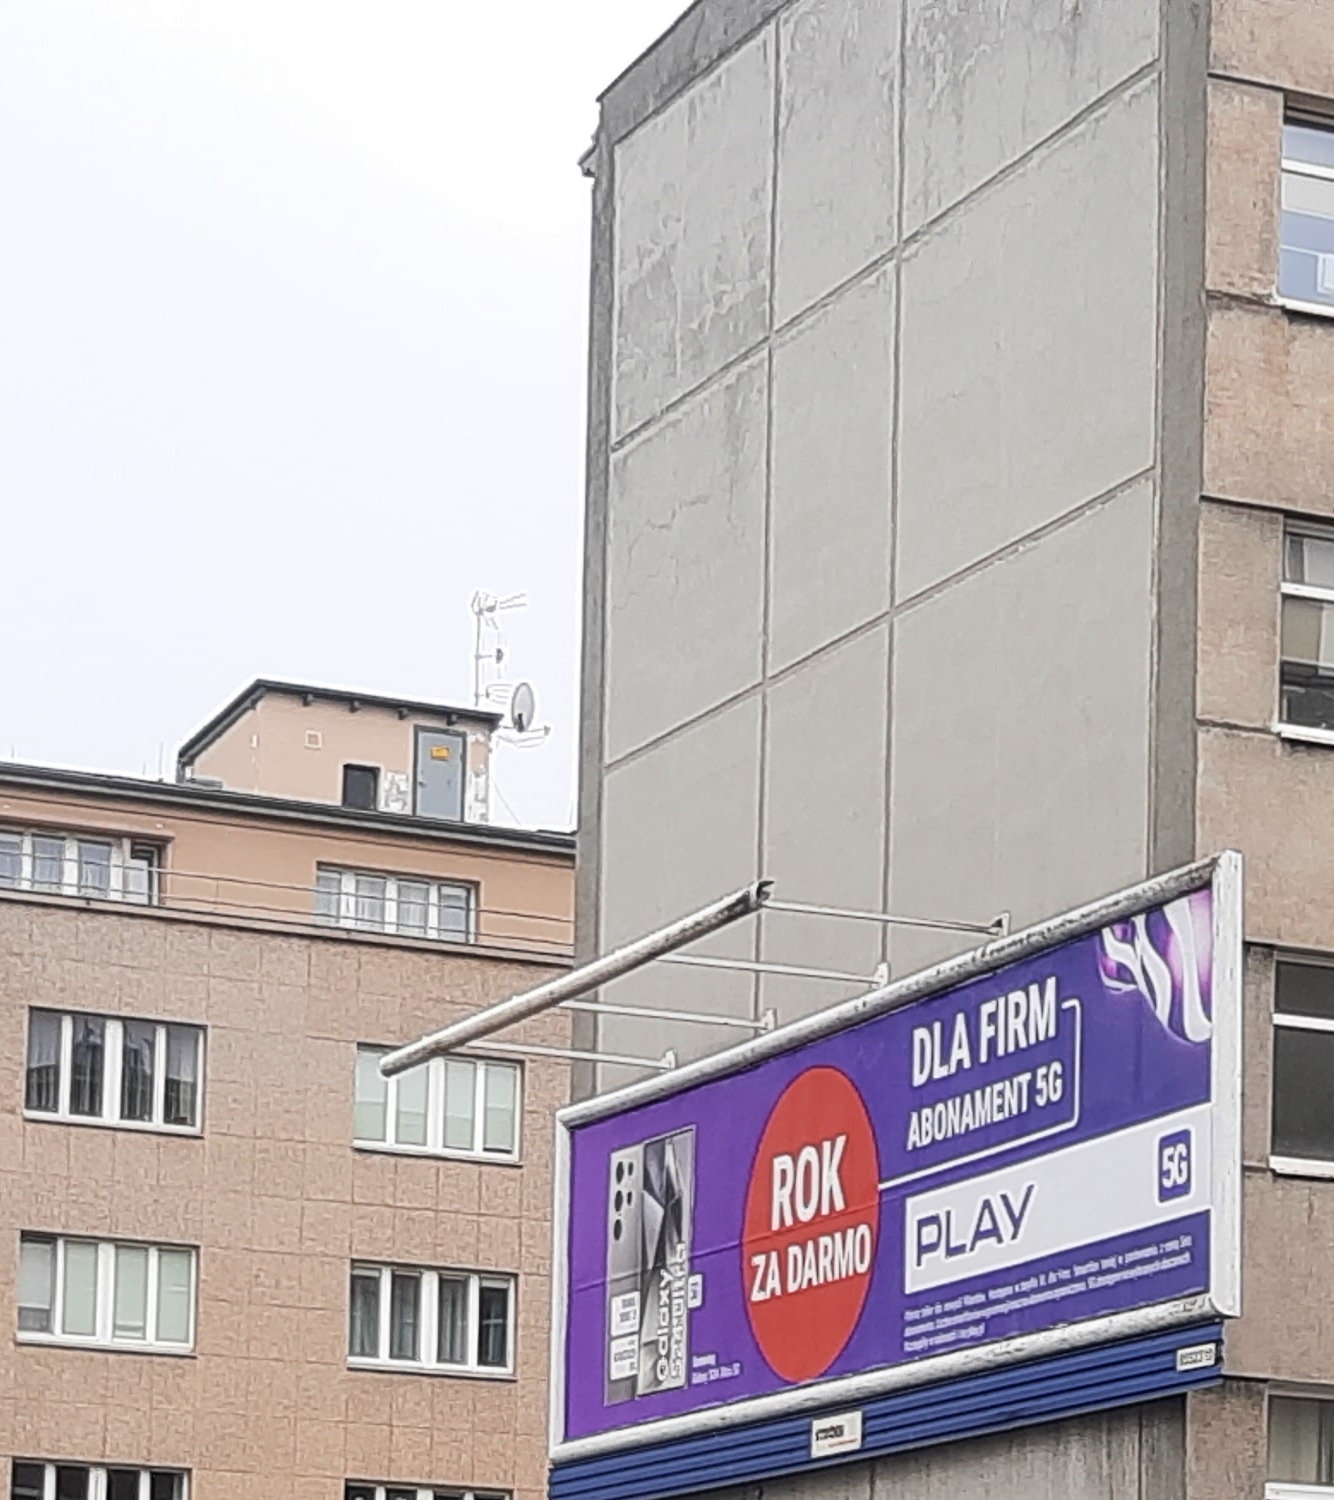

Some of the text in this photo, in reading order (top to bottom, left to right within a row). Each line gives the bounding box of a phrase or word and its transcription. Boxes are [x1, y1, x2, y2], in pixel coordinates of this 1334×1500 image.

[912, 976, 1057, 1087] DLA FIRM
[906, 1060, 1064, 1151] ABONAMENT 5G
[771, 1134, 847, 1231] ROK
[1161, 1143, 1189, 1189] 5G
[750, 1250, 782, 1302] ZA
[787, 1223, 872, 1294] DARMO
[916, 1184, 1036, 1268] PLAY
